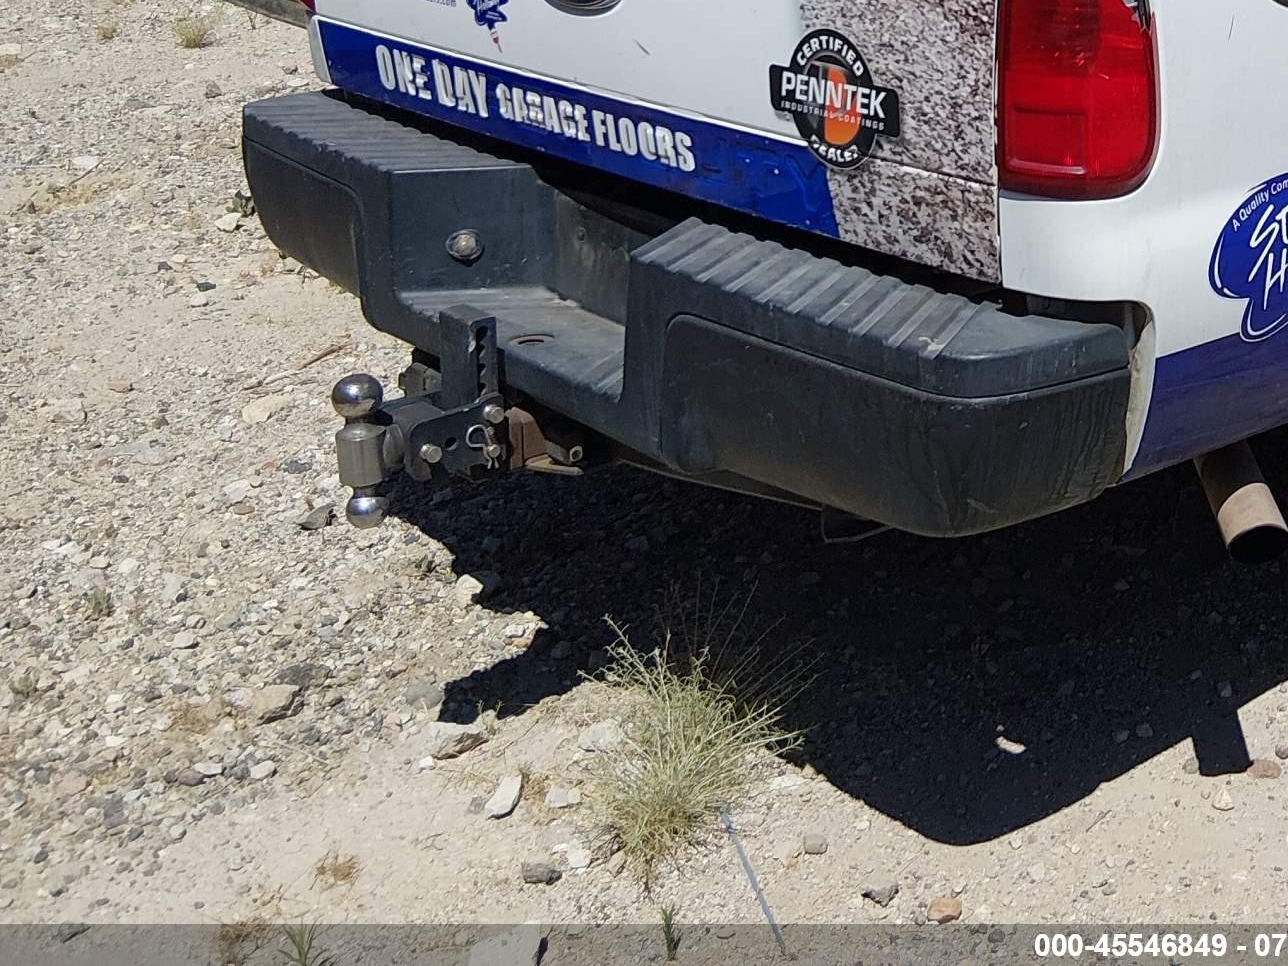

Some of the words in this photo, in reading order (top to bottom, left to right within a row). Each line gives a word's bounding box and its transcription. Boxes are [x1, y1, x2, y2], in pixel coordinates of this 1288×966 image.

[796, 35, 864, 76] CERTIFIED
[375, 44, 431, 100] ONE
[432, 58, 489, 118] DAY
[495, 83, 591, 142] GARAGE
[591, 109, 696, 172] FLOORS
[781, 71, 887, 119] PENNTEK
[781, 100, 834, 119] INDUSTRIAL
[838, 114, 885, 131] COATINGS
[1232, 219, 1240, 231] A
[1239, 189, 1269, 221] Quality
